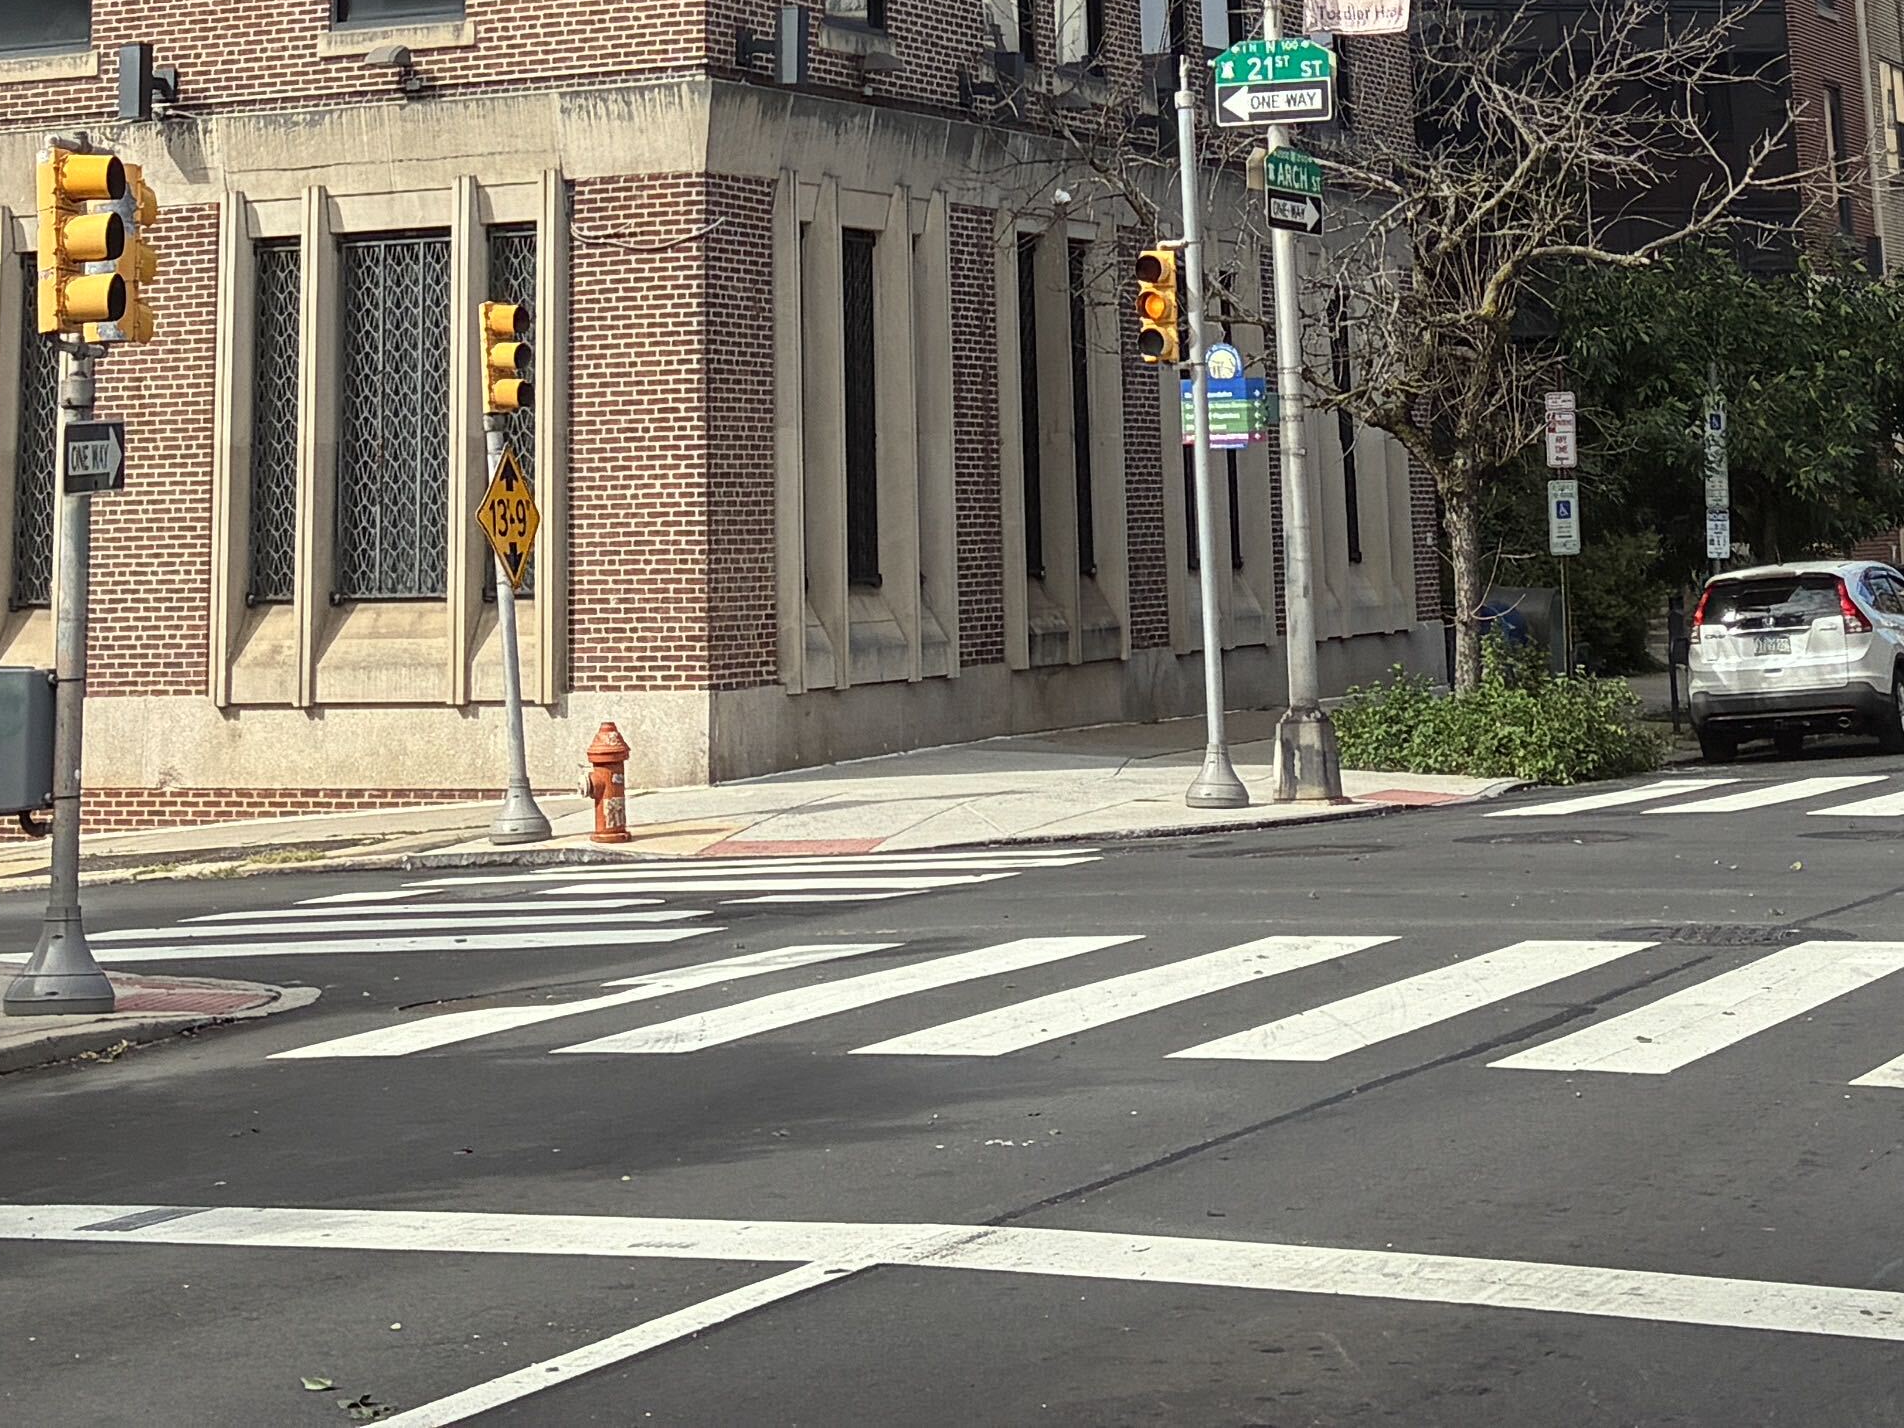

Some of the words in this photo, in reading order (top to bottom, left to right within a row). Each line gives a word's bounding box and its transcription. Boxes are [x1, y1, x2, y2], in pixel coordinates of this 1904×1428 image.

[1247, 55, 1290, 81] 21ST
[1300, 60, 1323, 78] ST
[1250, 94, 1280, 110] ONE
[1286, 92, 1317, 108] WAY
[1277, 162, 1308, 191] ARCH
[1311, 175, 1321, 193] ST
[71, 444, 90, 473] ONE
